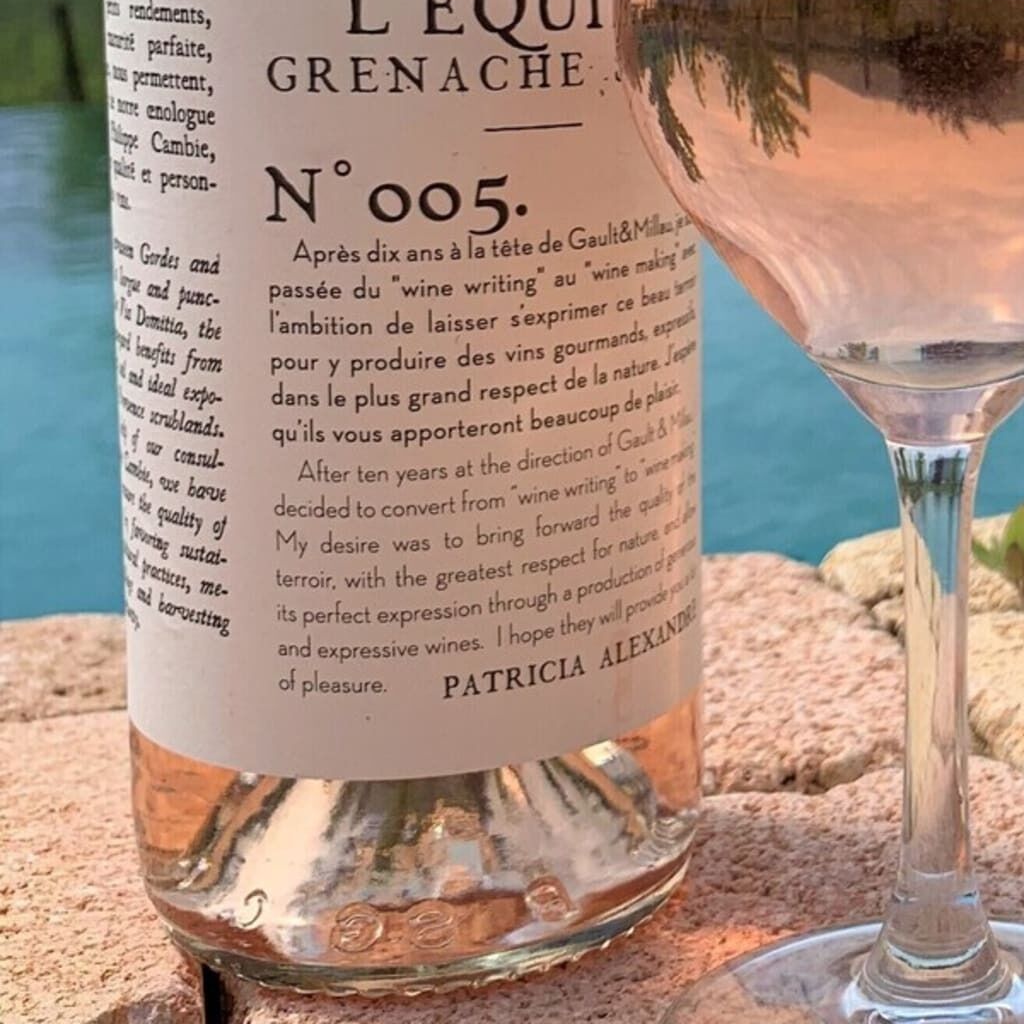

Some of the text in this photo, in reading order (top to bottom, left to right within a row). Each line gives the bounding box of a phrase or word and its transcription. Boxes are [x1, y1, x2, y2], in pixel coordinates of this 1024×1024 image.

[147, 34, 212, 63] parfaite,
[132, 70, 213, 96] permettent,
[267, 51, 584, 94] GRENACHE
[151, 131, 215, 163] Cambie,
[160, 172, 217, 193] person-
[140, 242, 179, 269] Gordes
[190, 253, 220, 274] and
[293, 238, 360, 268] Après
[368, 238, 400, 262] dix
[407, 248, 443, 262] ans
[451, 242, 461, 260] à
[468, 235, 485, 259] la
[492, 238, 533, 258] tête
[539, 230, 563, 254] de
[147, 280, 170, 300] and
[177, 286, 220, 310] punc-
[269, 281, 342, 304] passée
[353, 275, 381, 299] du
[392, 275, 453, 297] "wine
[465, 266, 544, 297] writing"
[554, 273, 577, 288] au
[585, 261, 630, 282] "wine
[136, 304, 188, 340] Domitia,
[198, 318, 222, 340] the
[270, 309, 373, 335] l'ambition
[386, 310, 414, 334] de
[428, 307, 498, 333] laisser
[510, 302, 608, 330] s'exprimer
[616, 297, 634, 312] ce
[641, 284, 671, 306] beau
[181, 348, 222, 375] from
[271, 356, 319, 376] pour
[328, 358, 340, 377] y
[351, 345, 447, 377] produire
[457, 342, 495, 367] des
[505, 344, 545, 362] vins
[148, 373, 176, 397] ideal
[183, 386, 222, 411] expo-
[271, 381, 320, 407] dans
[328, 382, 346, 407] le
[355, 382, 400, 413] plus
[408, 378, 471, 413] grand
[479, 374, 557, 404] respect
[564, 366, 588, 391] de
[594, 362, 608, 386] la
[150, 409, 224, 437] scrublands.
[272, 418, 326, 447] qu'ils
[333, 428, 383, 443] vous
[391, 414, 524, 448] apporteront
[530, 403, 620, 431] beaucoup
[624, 388, 642, 412] de
[174, 448, 224, 469] consul-
[298, 459, 349, 483] After
[358, 465, 388, 483] ten
[396, 466, 448, 488] years
[455, 460, 473, 478] at
[481, 452, 511, 476] the
[517, 447, 593, 472] direction
[598, 431, 613, 457] of
[617, 426, 655, 453] Gault
[188, 477, 226, 503] have
[274, 493, 350, 518] decided
[357, 500, 376, 518] to
[381, 496, 455, 518] convert
[461, 489, 505, 513] from
[511, 484, 560, 506] "wine
[564, 465, 621, 495] writing"
[624, 467, 638, 484] to
[157, 505, 204, 536] quality
[213, 515, 227, 540] of
[276, 529, 308, 559] My
[320, 530, 380, 554] desire
[392, 538, 431, 552] was
[444, 532, 463, 549] to
[477, 522, 524, 547] bring
[536, 504, 600, 538] forward
[609, 499, 632, 523] the
[180, 543, 227, 565] sustai-
[276, 569, 337, 590] terroir,
[344, 565, 386, 589] with
[395, 564, 427, 588] the
[435, 560, 513, 592] greatest
[521, 547, 586, 576] respect
[593, 536, 613, 561] for
[618, 528, 659, 554] nature
[142, 559, 229, 597] practices, me-
[277, 604, 297, 622] its
[303, 601, 371, 627] perfect
[377, 601, 482, 627] expression
[488, 583, 557, 614] through
[563, 589, 572, 602] a
[577, 566, 653, 604] production
[158, 592, 230, 637] harvesting
[278, 635, 311, 658] and
[318, 640, 419, 664] expressive
[425, 636, 484, 656] wines.
[497, 625, 502, 647] I
[509, 623, 555, 647] hope
[560, 612, 596, 636] they
[599, 599, 622, 626] will
[626, 585, 668, 623] provide
[278, 668, 296, 692] of
[302, 670, 388, 698] pleasure.
[443, 655, 586, 700] PATRICIA
